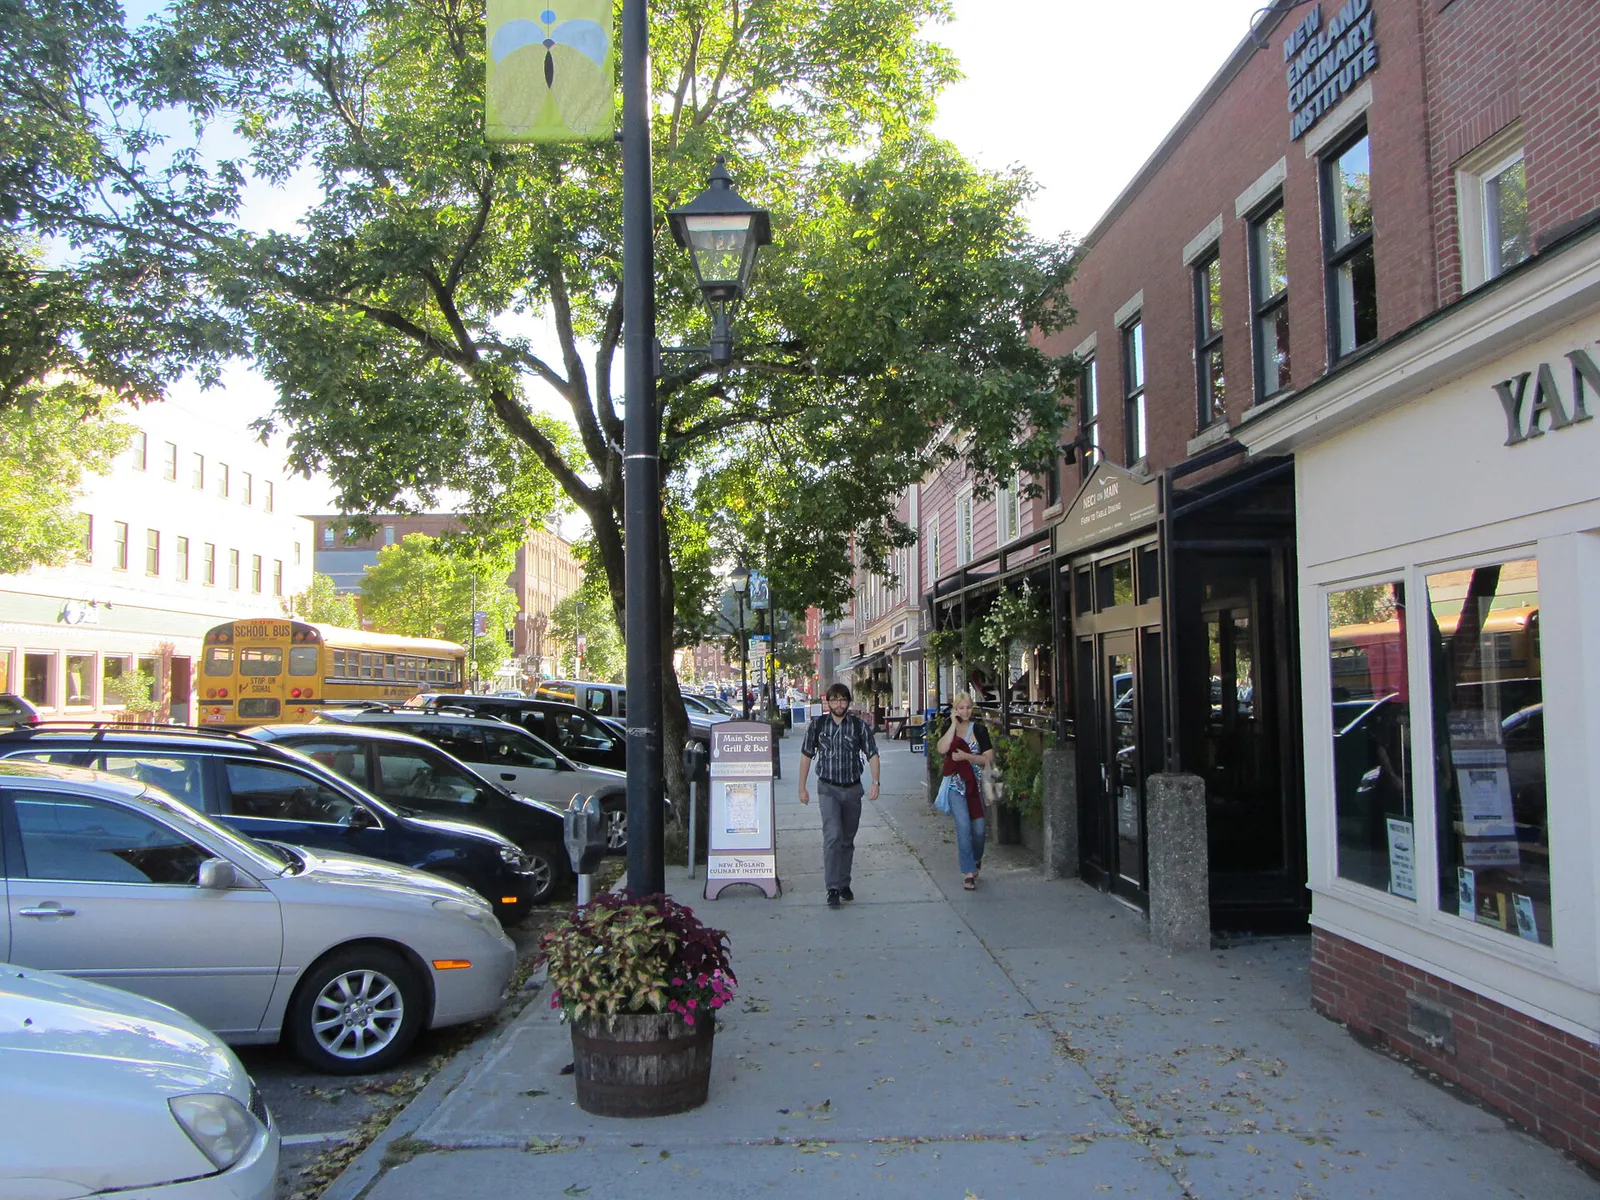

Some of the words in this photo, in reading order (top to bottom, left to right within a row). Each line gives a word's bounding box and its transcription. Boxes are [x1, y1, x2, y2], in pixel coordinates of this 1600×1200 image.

[1283, 3, 1321, 63] NEW
[1286, 0, 1370, 91] ENGLAND
[1287, 9, 1375, 113] CULINARY
[1289, 40, 1377, 142] INSTITUTE
[1103, 483, 1119, 500] MAIN
[234, 624, 270, 637] SCHOOL
[272, 624, 291, 637] BUS
[250, 677, 265, 685] STOP
[267, 677, 276, 685] ON
[252, 685, 271, 693] SIGNAL
[722, 734, 743, 742] Main
[744, 734, 769, 742] Street
[722, 744, 742, 752] Grill
[743, 744, 751, 752] &
[752, 744, 769, 752] Bar
